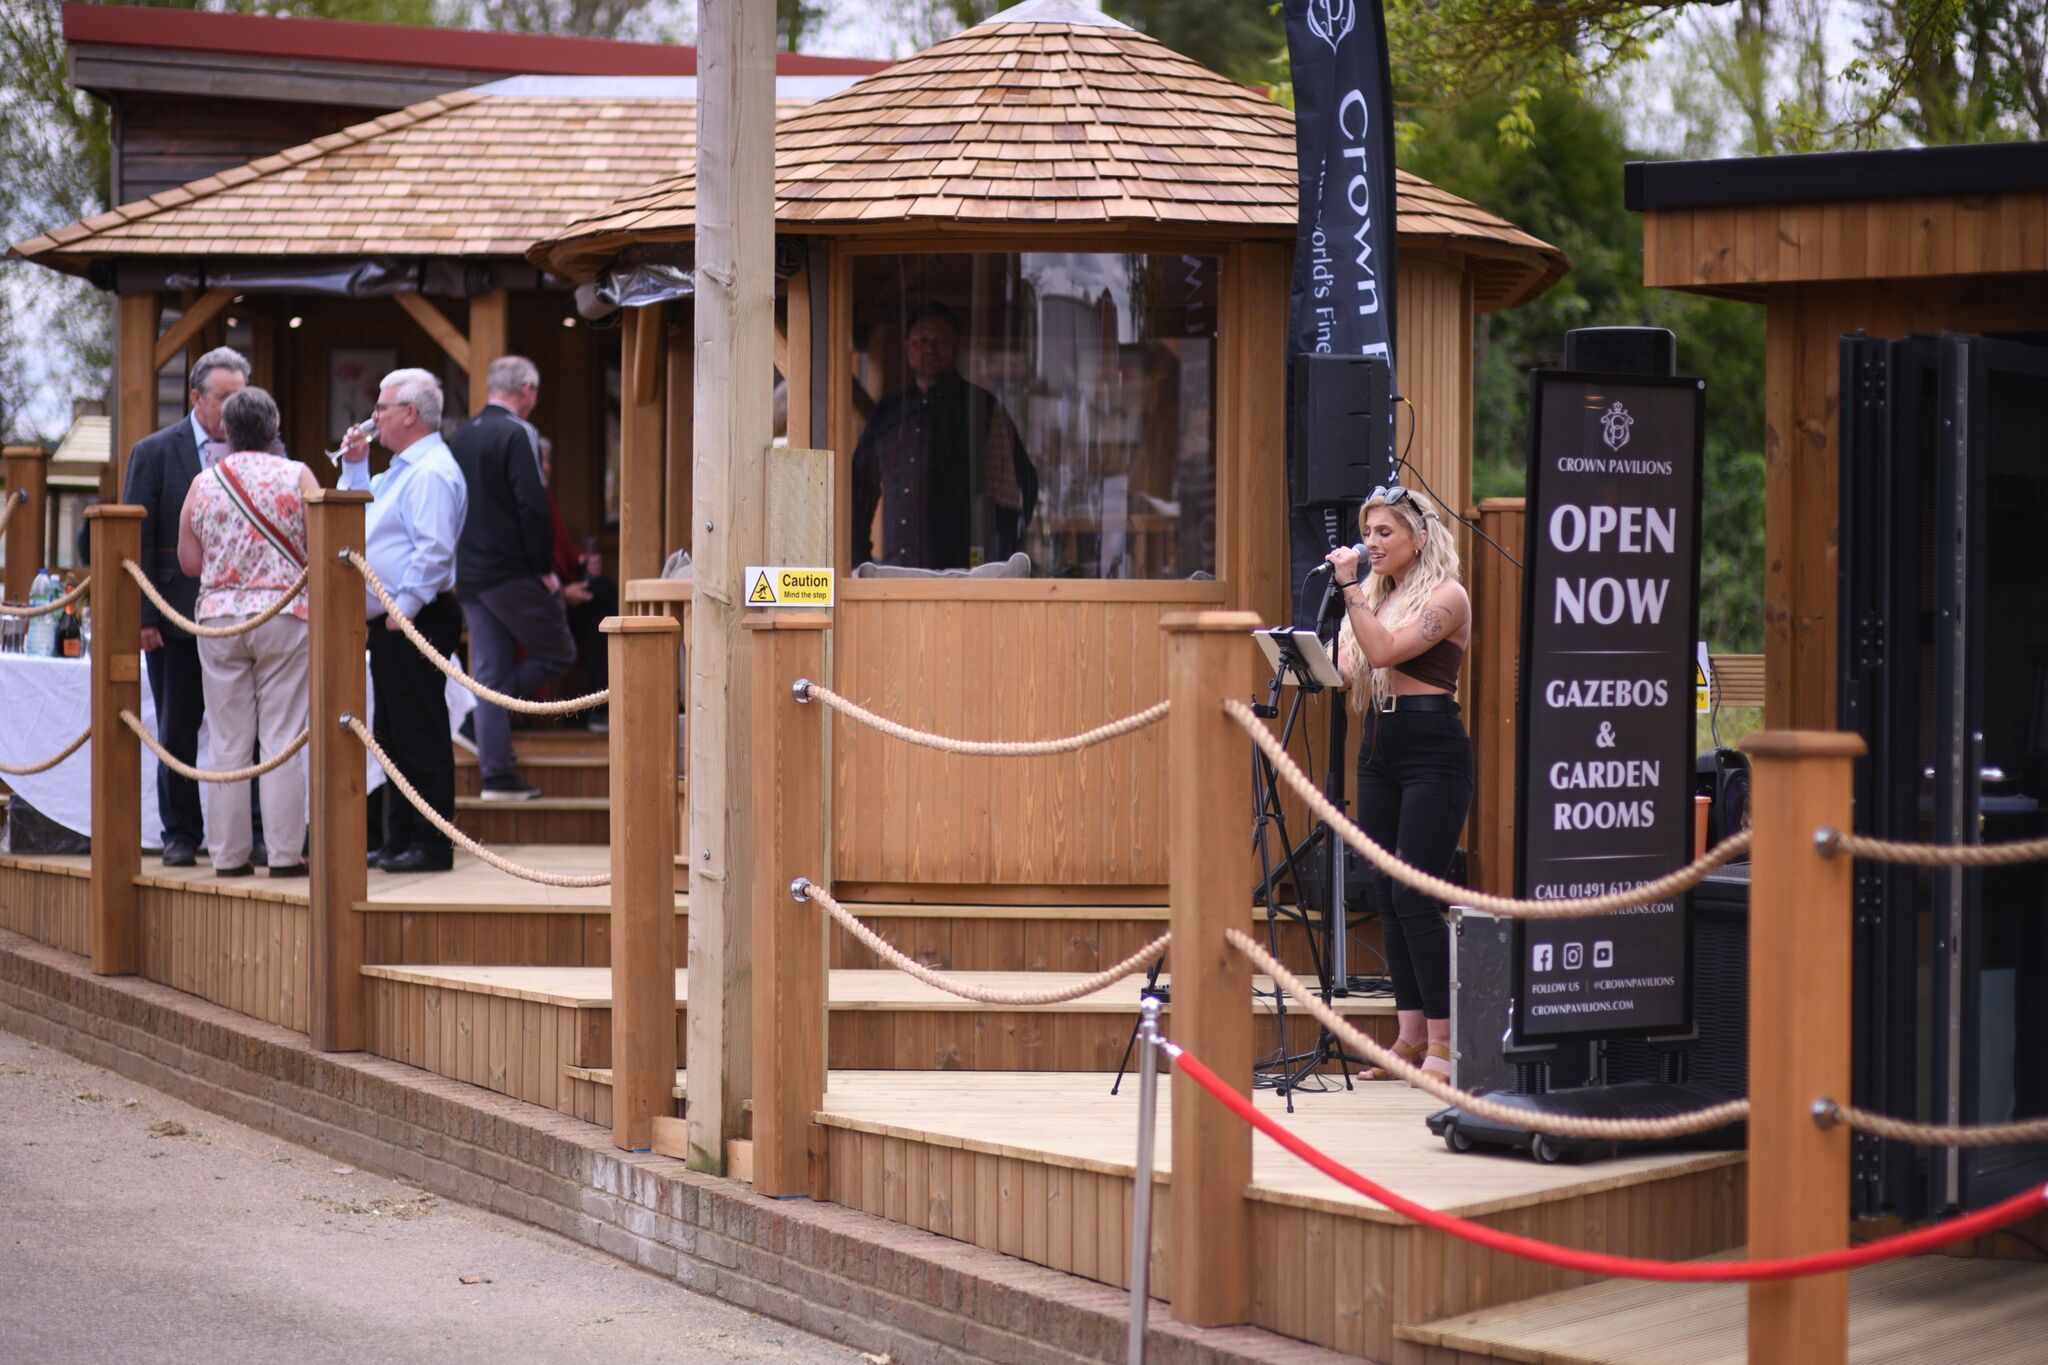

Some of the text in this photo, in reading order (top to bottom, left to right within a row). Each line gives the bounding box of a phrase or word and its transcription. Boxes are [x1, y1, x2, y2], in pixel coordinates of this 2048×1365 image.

[1339, 88, 1380, 315] Crown
[1558, 457, 1673, 476] CROWN PAVILIONS
[1549, 504, 1676, 553] OPEN
[782, 574, 828, 587] Caution
[813, 592, 827, 600] step
[1554, 577, 1670, 625] NOW
[1546, 680, 1669, 708] GAZEBOS
[1596, 721, 1617, 748] &
[1550, 760, 1660, 790] GARDEN
[1554, 800, 1655, 831] ROOMS
[1535, 884, 1567, 900] CALL
[1569, 883, 1605, 898] 01491
[1610, 881, 1632, 896] 612
[1532, 976, 1675, 994] FOLLOW US @CROWNPAVILIONS
[1531, 1000, 1634, 1016] CROWNPAVILIONS.COM
